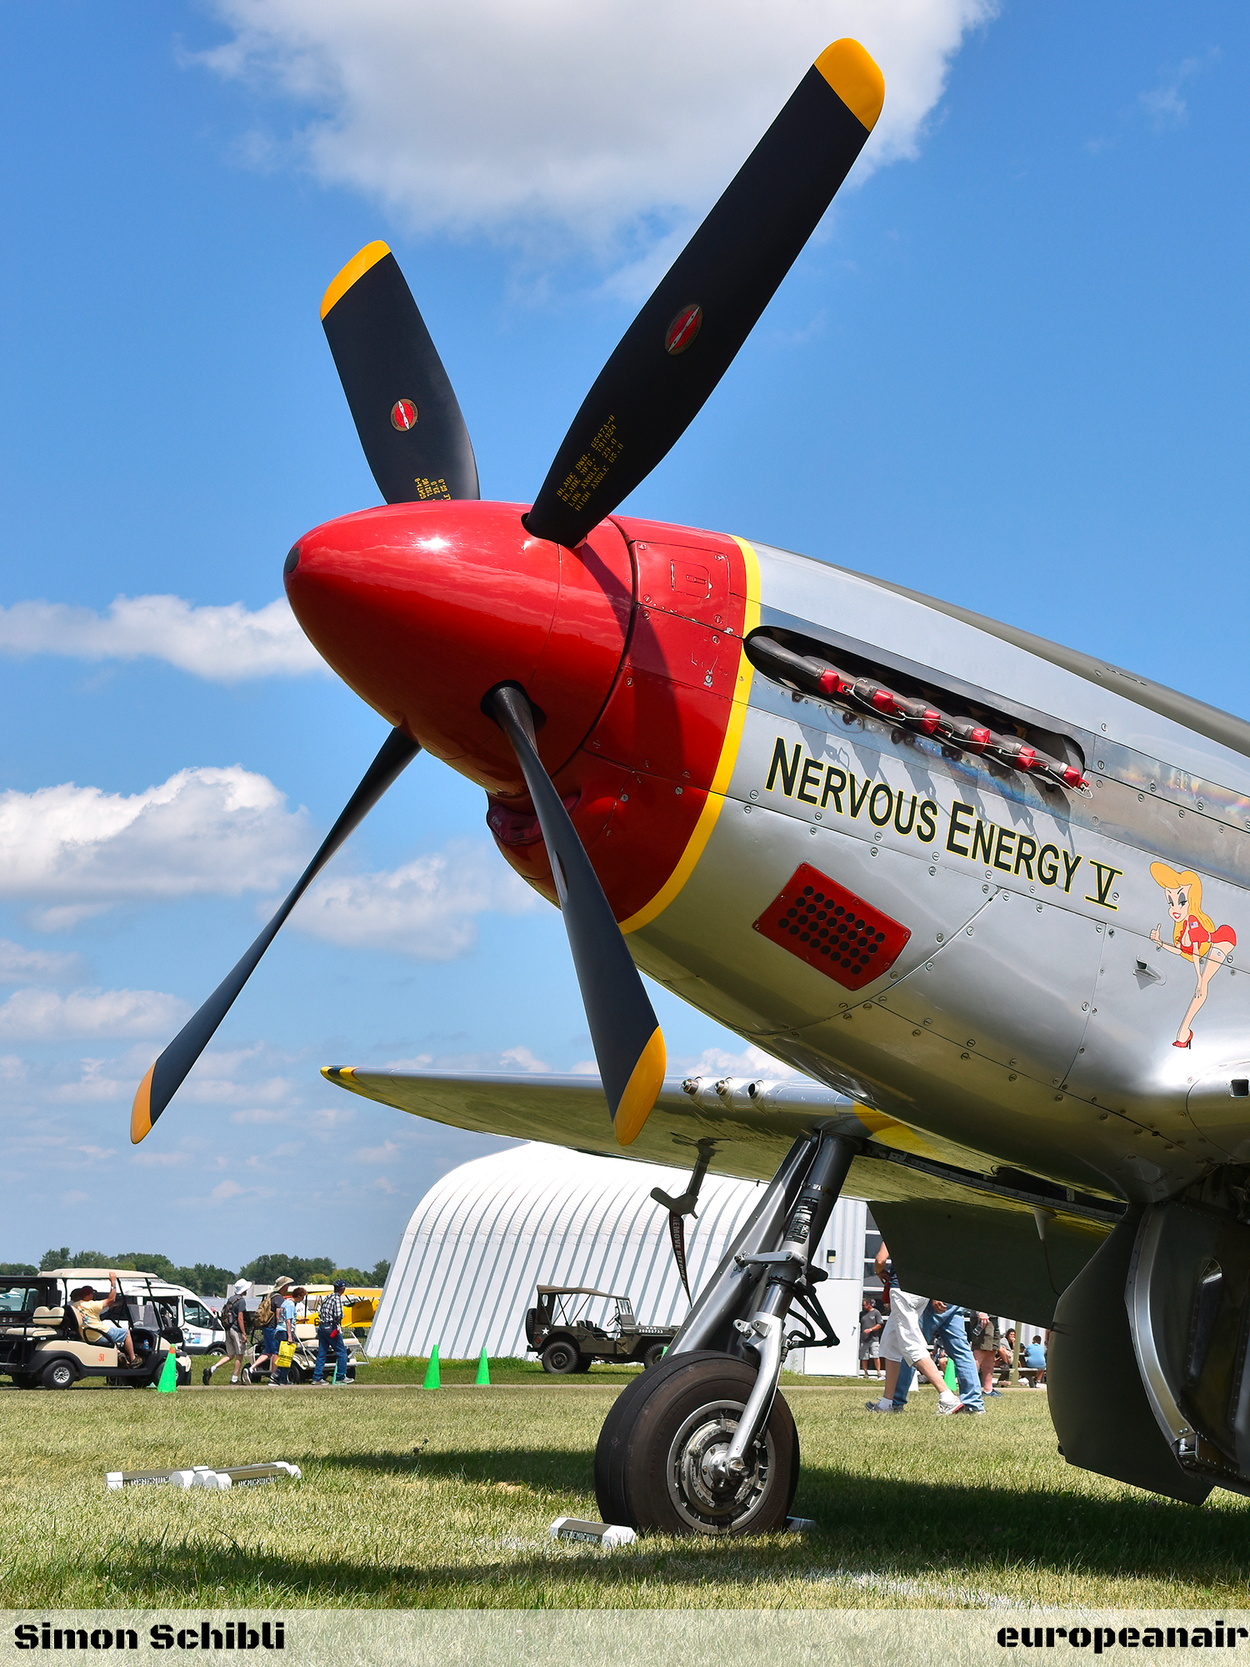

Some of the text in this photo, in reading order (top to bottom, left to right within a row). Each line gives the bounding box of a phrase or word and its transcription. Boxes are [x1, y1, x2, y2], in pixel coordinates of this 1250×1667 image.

[765, 736, 1124, 910] NERVOUS ENERGY V
